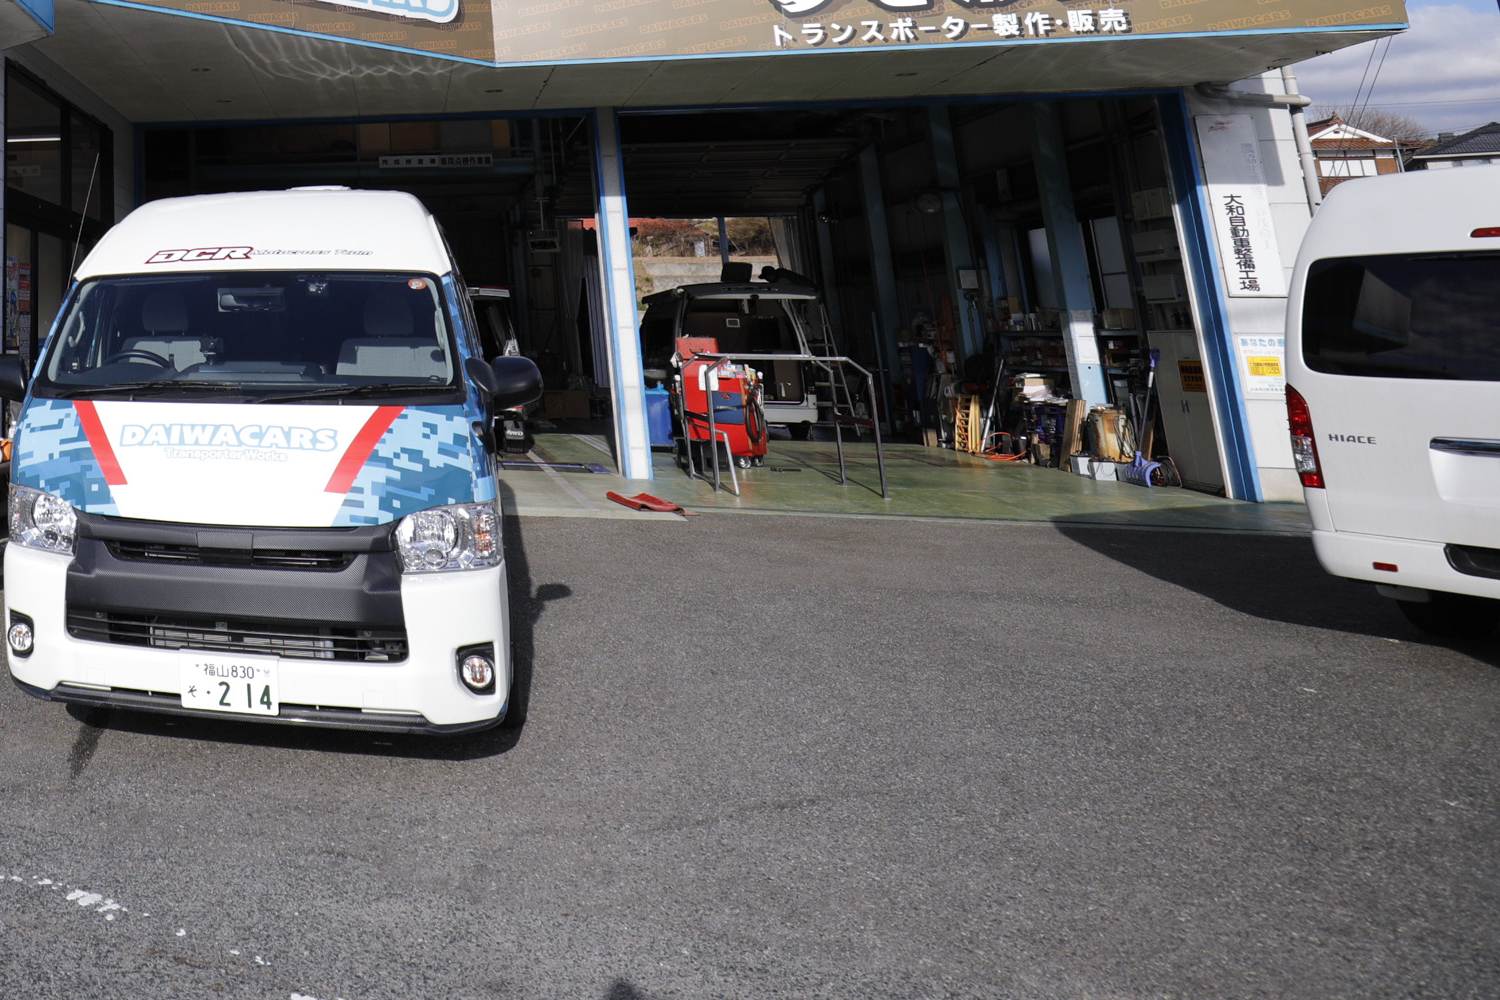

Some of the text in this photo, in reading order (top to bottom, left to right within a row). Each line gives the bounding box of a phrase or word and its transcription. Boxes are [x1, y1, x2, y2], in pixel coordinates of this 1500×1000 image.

[186, 2, 240, 12] DAIWACARS
[1305, 5, 1392, 26] DAIWACARS
[772, 8, 1130, 48] トランスポーター製作・販売
[1223, 194, 1260, 292] 大和自動車整備工場
[145, 246, 254, 264] DCR
[119, 423, 339, 452] DAIWACARS
[1329, 433, 1377, 445] HIACE
